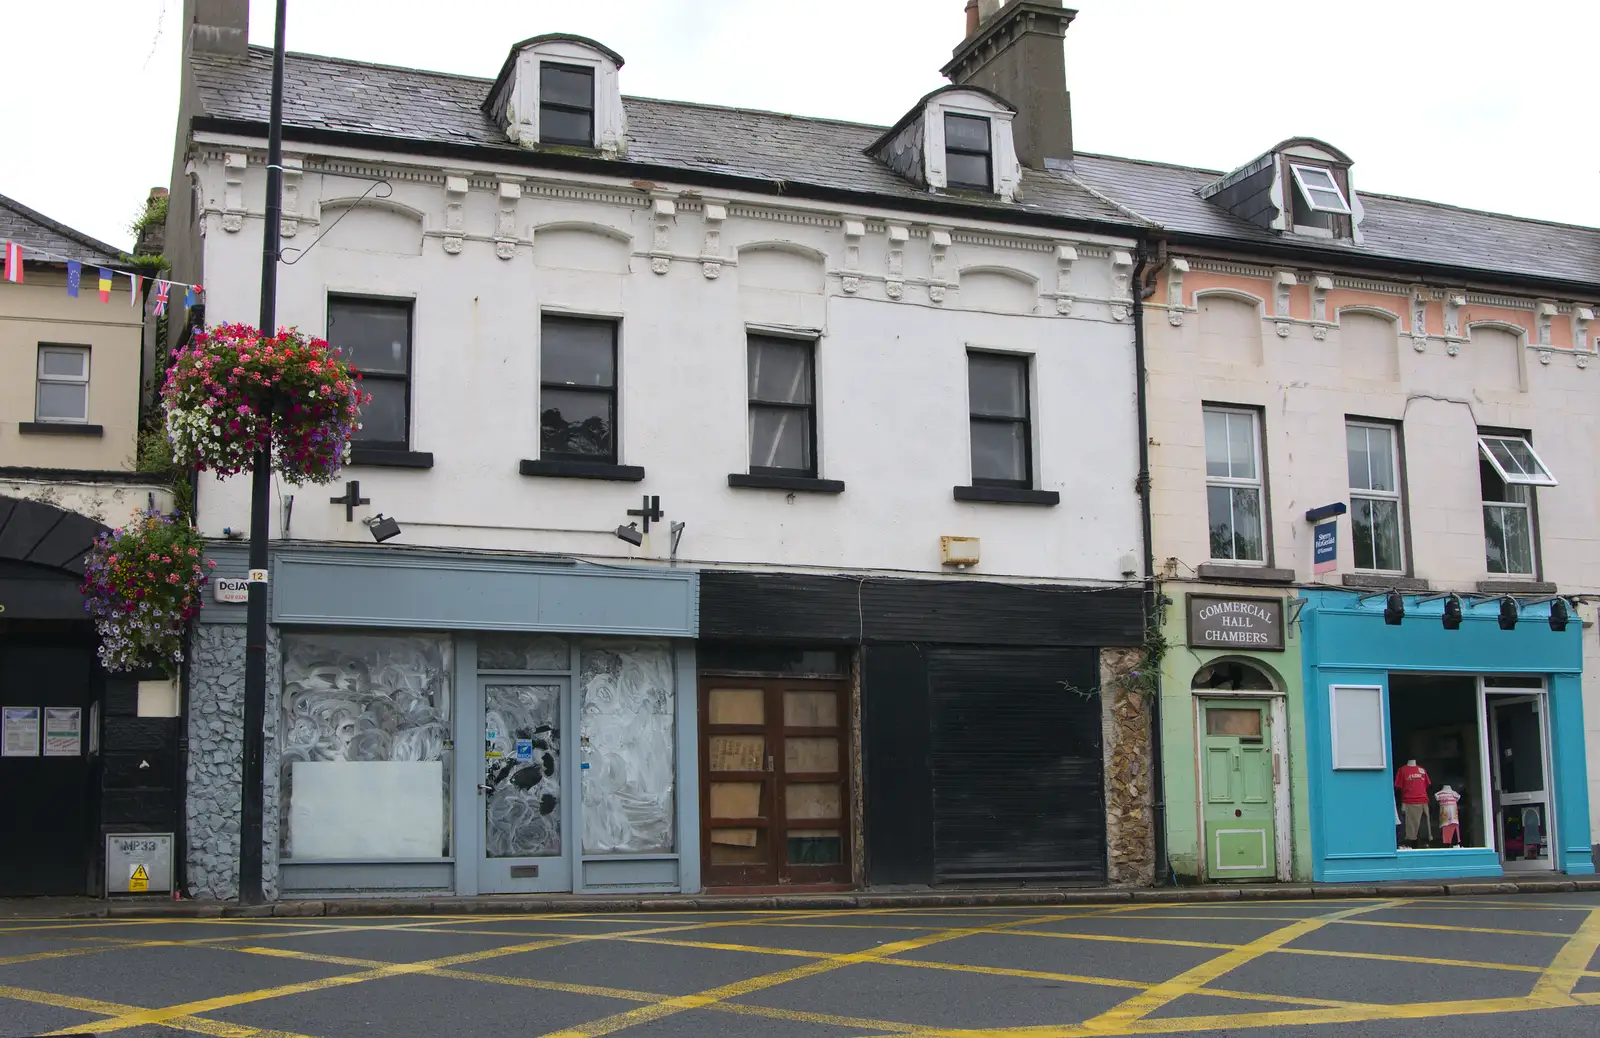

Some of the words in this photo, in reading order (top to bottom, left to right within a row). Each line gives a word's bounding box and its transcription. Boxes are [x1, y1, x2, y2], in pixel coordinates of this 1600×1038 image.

[252, 572, 263, 580] 12
[1199, 601, 1272, 624] COMMERCIAL
[1222, 616, 1253, 628] HALL
[1205, 630, 1268, 643] CHAMBERS
